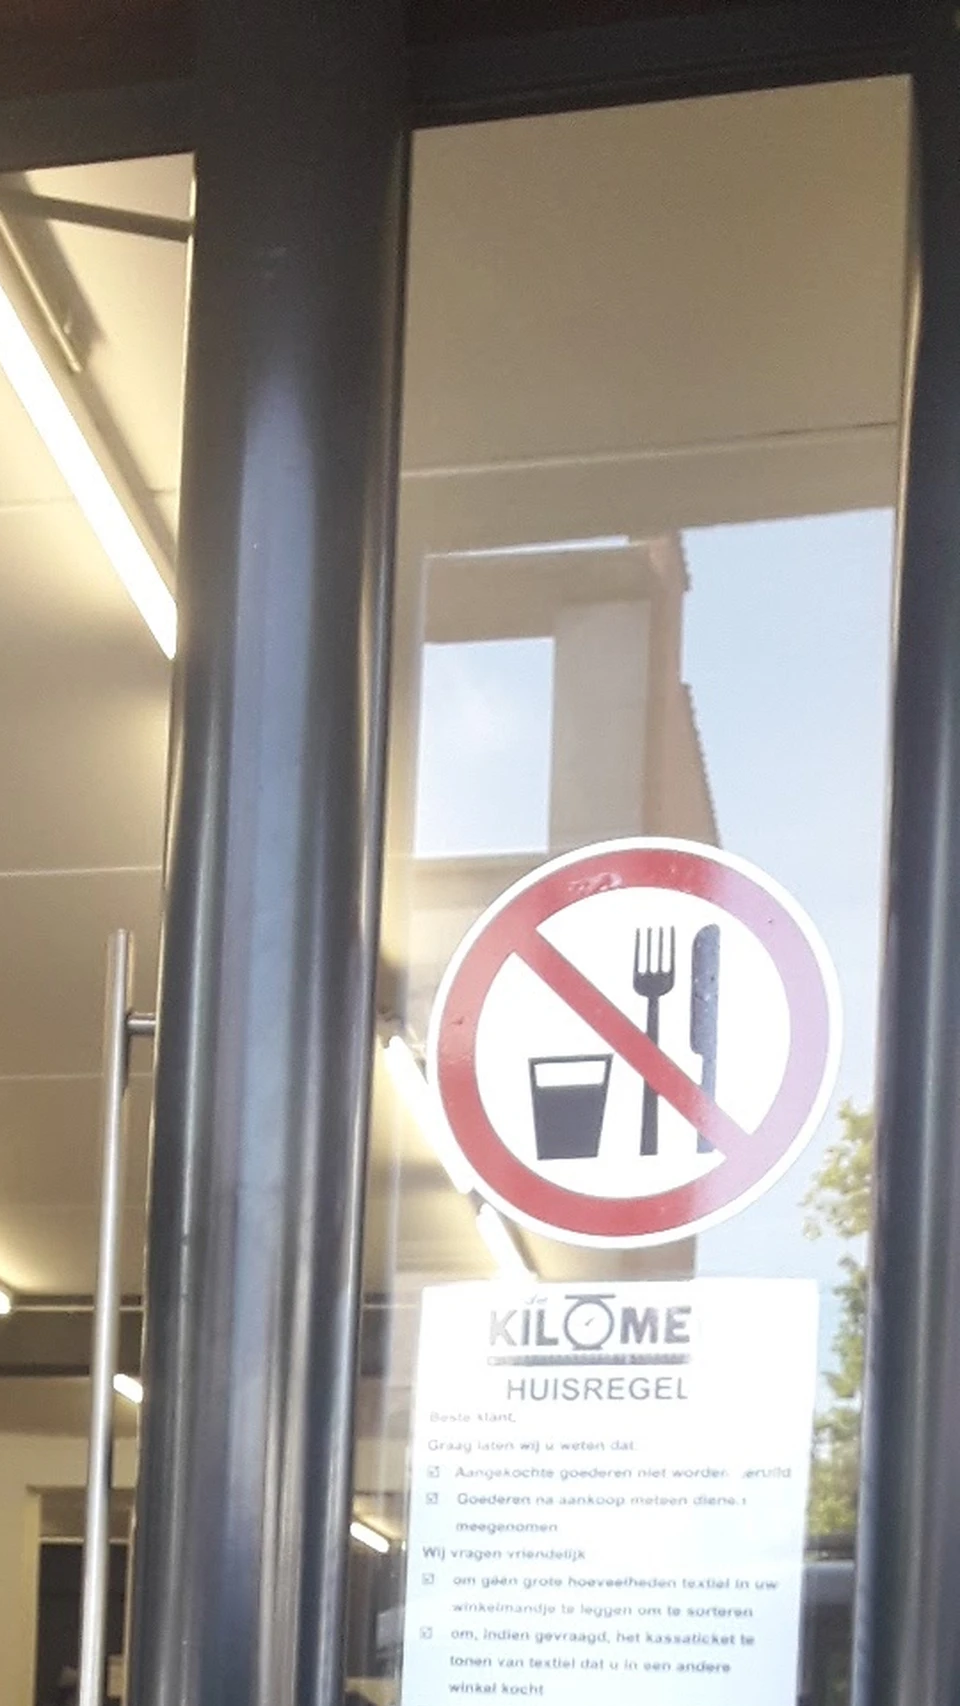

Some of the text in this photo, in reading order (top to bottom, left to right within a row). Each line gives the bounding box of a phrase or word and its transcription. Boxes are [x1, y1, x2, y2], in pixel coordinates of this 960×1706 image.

[428, 1439, 472, 1454] Graag
[520, 1441, 540, 1454] wij
[545, 1442, 554, 1451] u
[561, 1440, 605, 1451] weten
[455, 1466, 554, 1481] Aangekochte
[560, 1466, 632, 1481] goederen
[637, 1467, 667, 1478] niet
[457, 1493, 531, 1505] Goederen
[536, 1495, 554, 1505] na
[559, 1494, 625, 1508] aankoop
[631, 1495, 688, 1506] meteen
[455, 1522, 558, 1535] meegenomen
[422, 1545, 586, 1562] Wij vragen vriendelijk
[452, 1576, 476, 1586] om
[522, 1576, 563, 1589] grote
[568, 1575, 676, 1589] hoeveelheden
[682, 1577, 730, 1589] textiel
[735, 1578, 750, 1589] in
[754, 1580, 778, 1590] uw
[451, 1601, 753, 1618] winkelmandje te leggen om te sorteren
[450, 1628, 755, 1646] om, indien gevraagd, het kassaticket te
[450, 1655, 731, 1672] tonen van textiel dat u in een andere
[448, 1680, 544, 1696] winkel kocht
